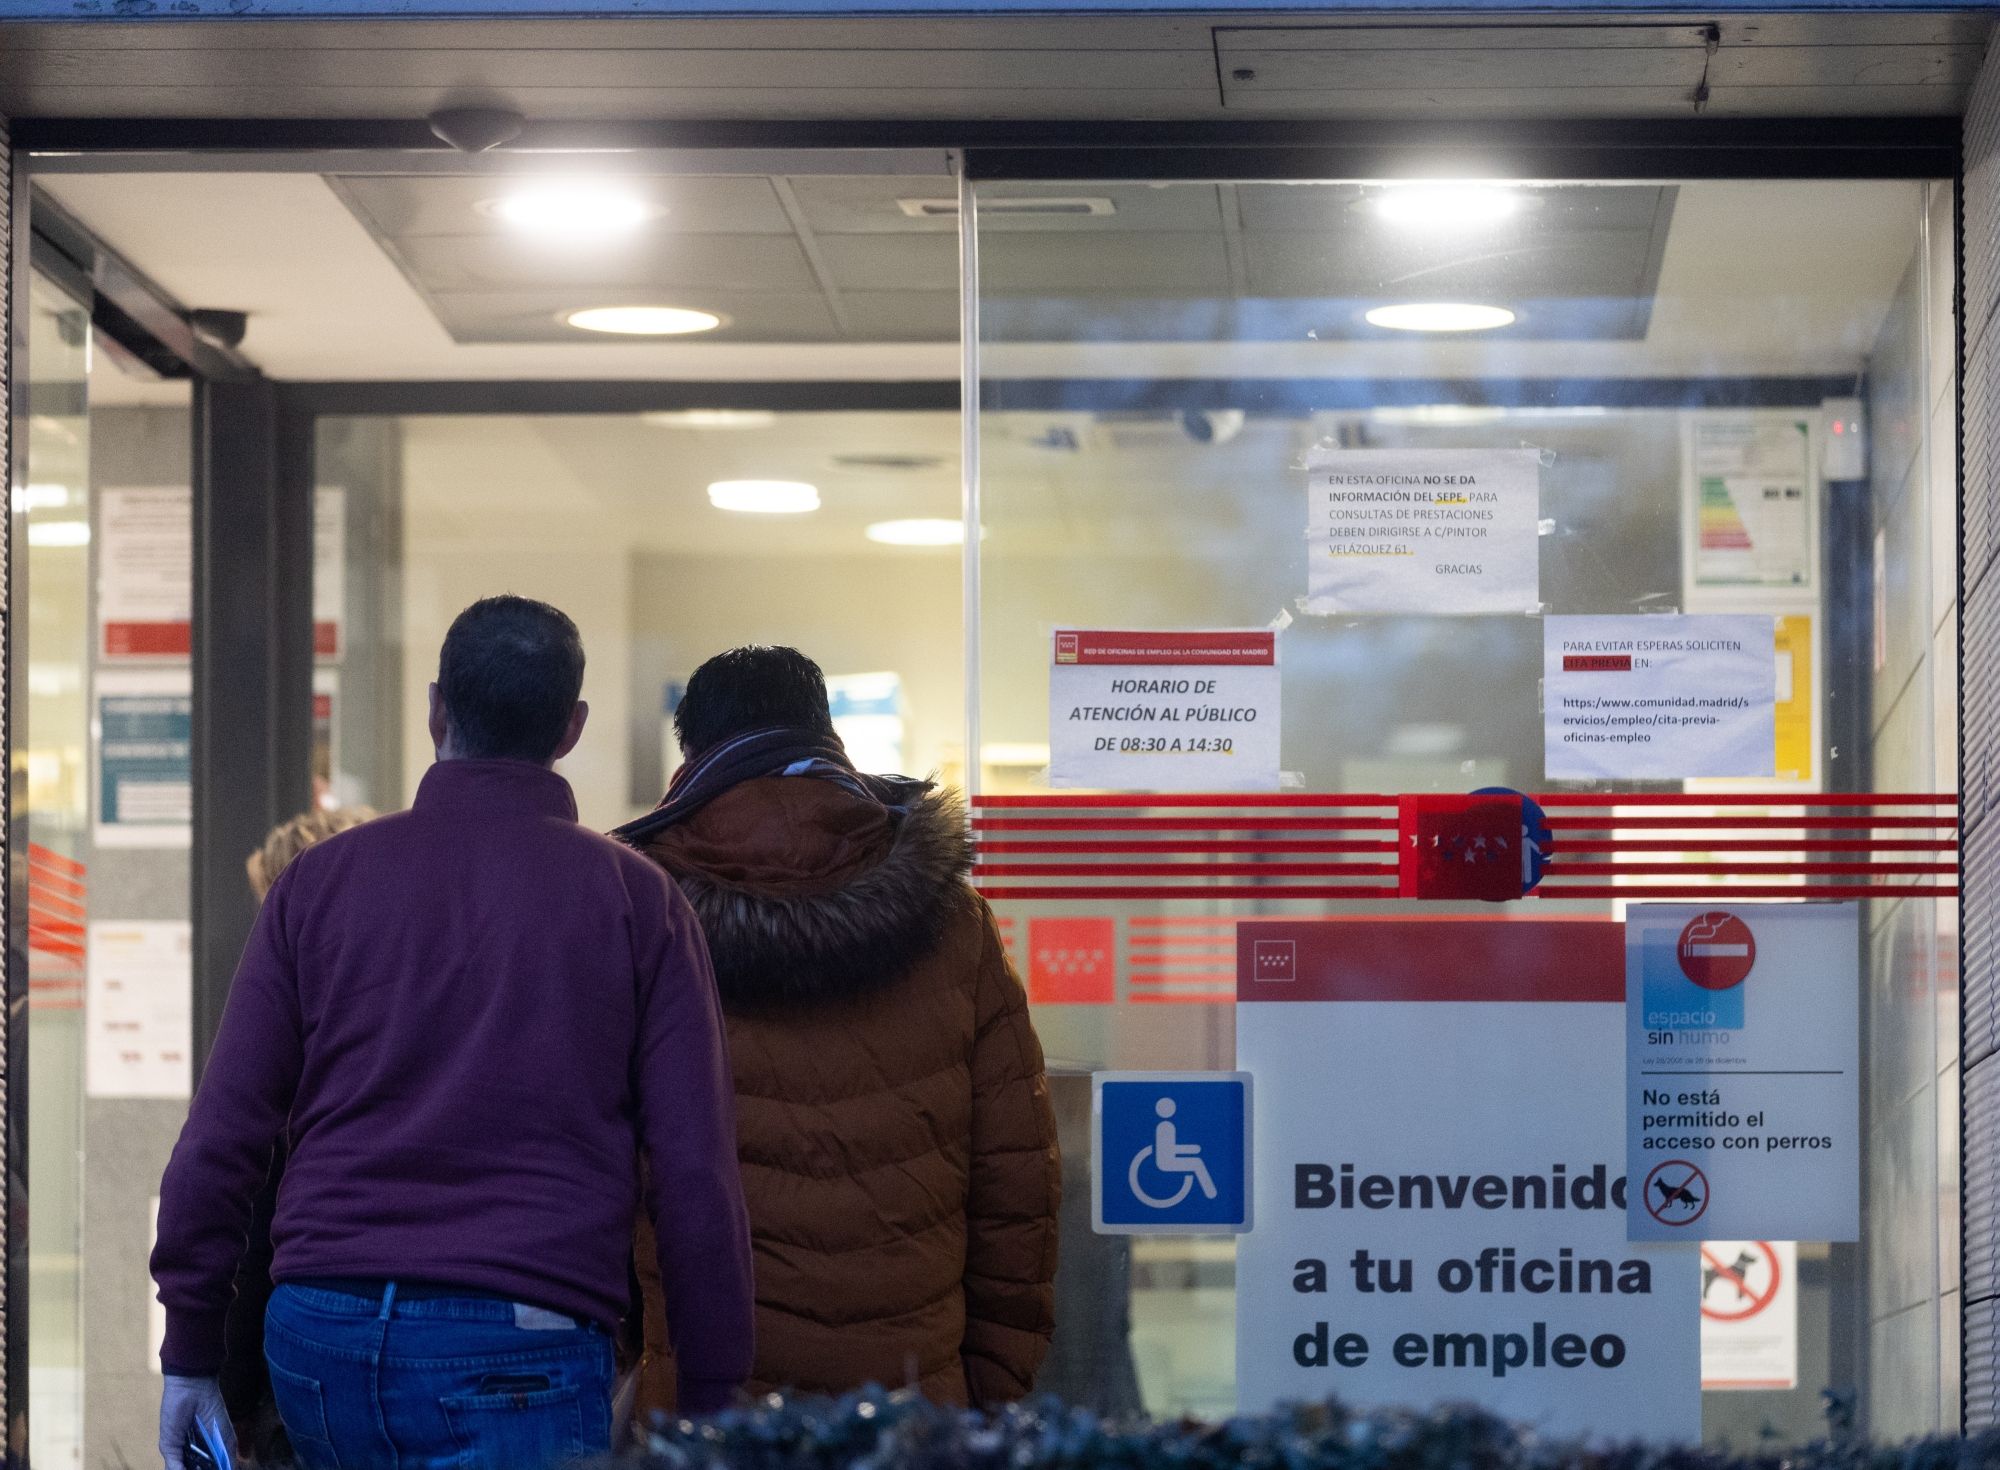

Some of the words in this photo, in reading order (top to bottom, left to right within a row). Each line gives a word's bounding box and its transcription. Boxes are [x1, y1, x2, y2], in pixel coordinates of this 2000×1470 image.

[1329, 476, 1344, 485] EN
[1347, 476, 1373, 485] ESTA
[1377, 476, 1420, 485] OFICINA
[1424, 476, 1440, 485] NO
[1444, 476, 1456, 485] SE
[1460, 476, 1475, 485] DA
[1329, 491, 1410, 502] INFORMACIÓN
[1414, 492, 1433, 502] DEL
[1470, 493, 1497, 502] PARA
[1329, 510, 1392, 519] CONSULTAS
[1397, 510, 1410, 519] DE
[1414, 510, 1493, 520] PRESTACIONES
[1330, 527, 1365, 537] DEBEN
[1369, 527, 1420, 537] DIRIGIRSE
[1424, 527, 1431, 537] A
[1434, 527, 1487, 538] C/PINTOR
[1329, 541, 1391, 554] VELÁZQUEZ
[1436, 564, 1482, 574] GRACIAS
[1563, 641, 1592, 651] PARA
[1595, 641, 1633, 651] EVITAR
[1637, 641, 1682, 650] ESPERAS
[1686, 641, 1741, 651] SOLICITEN
[1634, 659, 1652, 668] EN:
[1111, 680, 1189, 693] HORARIO
[1194, 680, 1216, 693] DE
[1069, 704, 1155, 721] ATENCIÓN
[1160, 708, 1180, 721] AL
[1185, 705, 1257, 722] PÚBLICO
[1563, 732, 1651, 743] oficinas-empleo
[1094, 738, 1116, 751] DE
[1120, 738, 1165, 752] 08:30
[1170, 738, 1181, 752] A
[1187, 738, 1232, 752] 14:30
[1648, 1009, 1716, 1028] espacio
[1648, 1027, 1673, 1045] sin
[1680, 1027, 1730, 1045] humo
[1643, 1090, 1670, 1106] No
[1677, 1089, 1720, 1106] está
[1643, 1111, 1740, 1130] permitido
[1747, 1111, 1764, 1127] el
[1643, 1135, 1715, 1149] acceso
[1723, 1135, 1760, 1149] con
[1767, 1135, 1832, 1152] perros
[1293, 1258, 1328, 1293] a
[1350, 1249, 1413, 1293] tu
[1437, 1248, 1651, 1293] oficina
[1293, 1322, 1369, 1368] de
[1393, 1322, 1626, 1377] empleo
